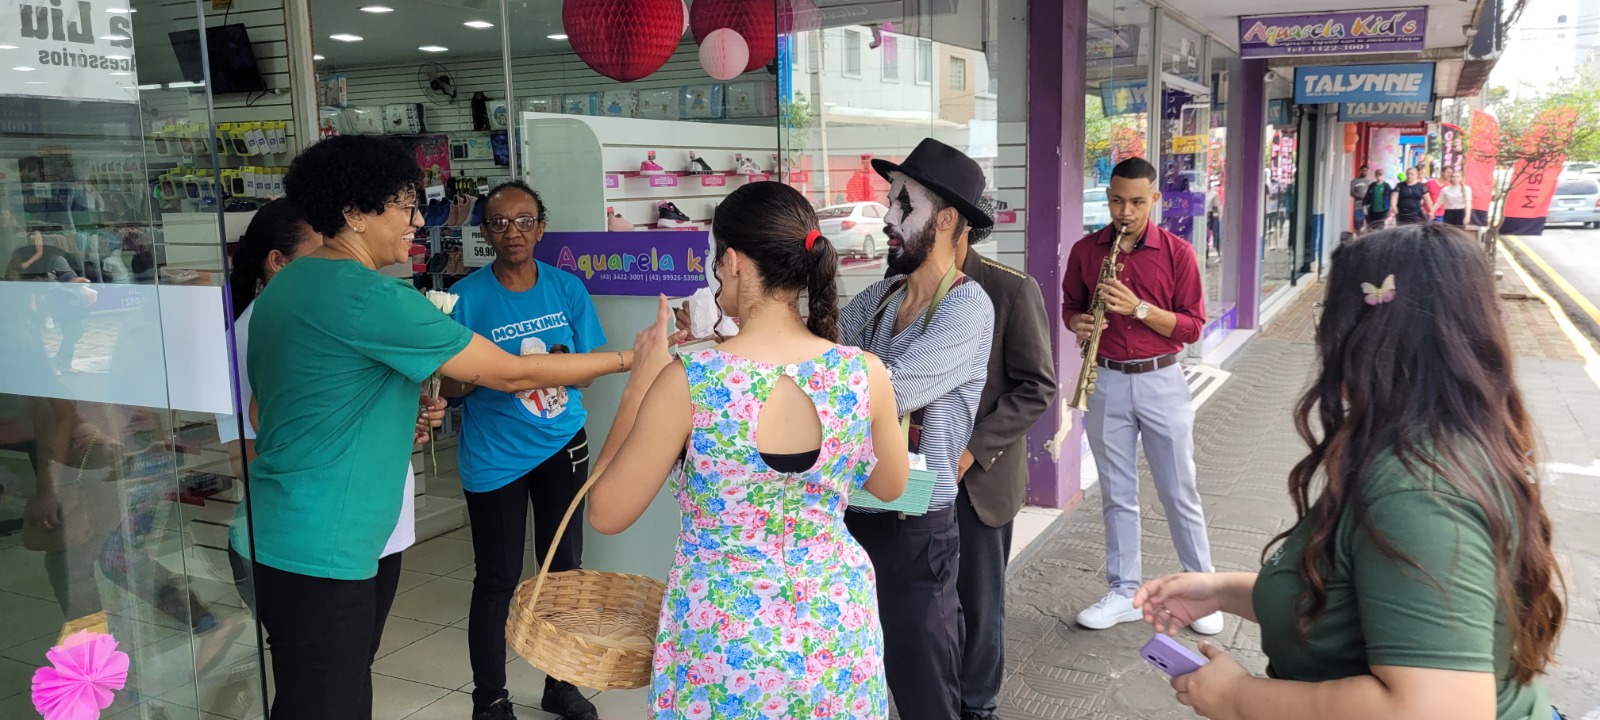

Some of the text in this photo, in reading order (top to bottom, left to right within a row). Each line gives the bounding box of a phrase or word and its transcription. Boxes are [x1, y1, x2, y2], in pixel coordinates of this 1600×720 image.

[1243, 12, 1417, 46] Aquarela Kid's
[1304, 72, 1424, 93] TALYNNE
[1346, 102, 1428, 115] TALYNNE
[474, 246, 495, 257] 59,90
[556, 246, 675, 280] Aquarela
